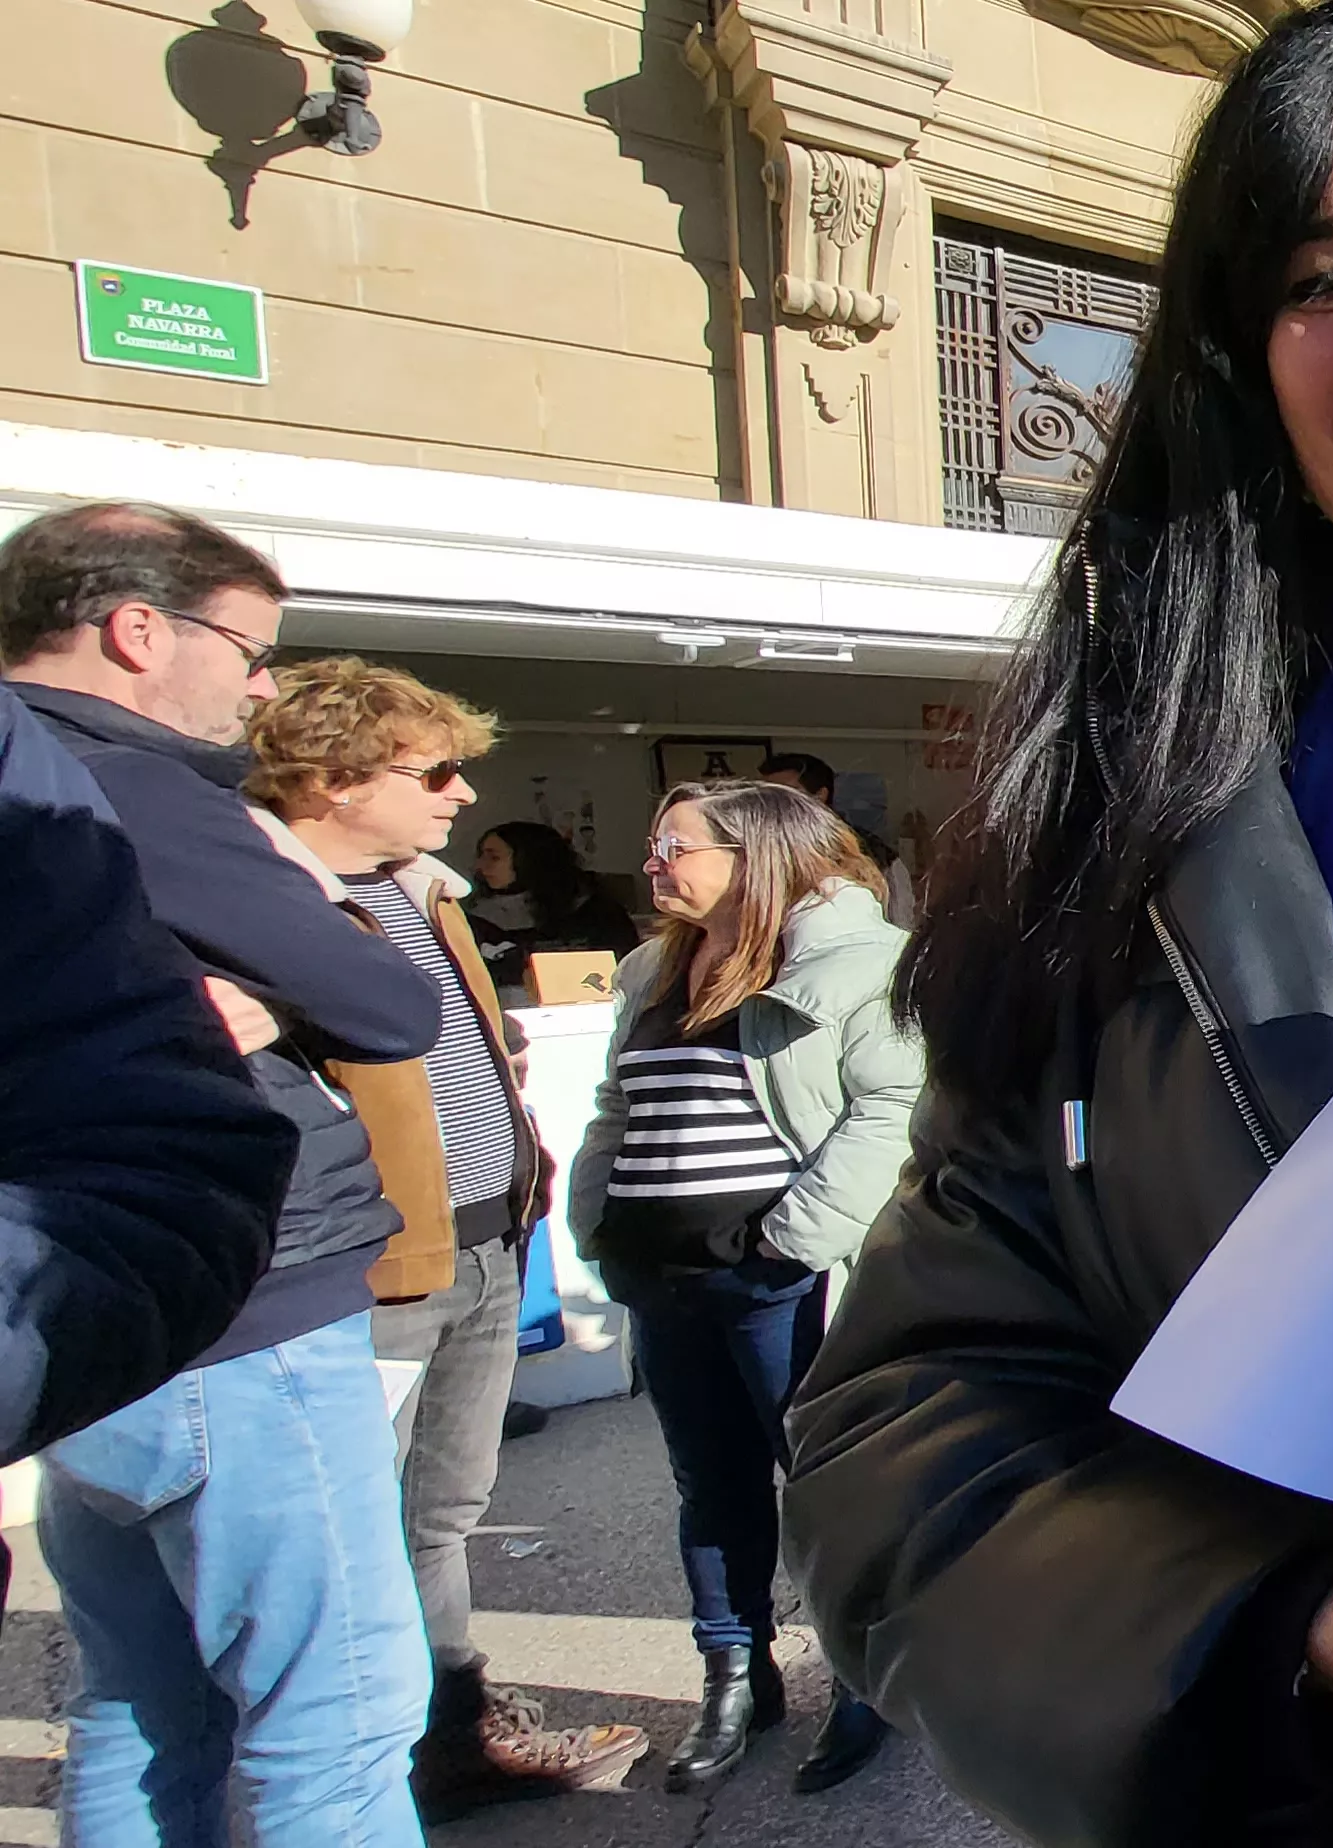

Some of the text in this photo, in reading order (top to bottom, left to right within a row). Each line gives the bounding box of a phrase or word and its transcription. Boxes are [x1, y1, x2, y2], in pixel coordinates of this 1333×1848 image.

[141, 297, 212, 321] PLAZA
[127, 313, 227, 341] NAVARRA
[114, 331, 197, 355] Comunidad
